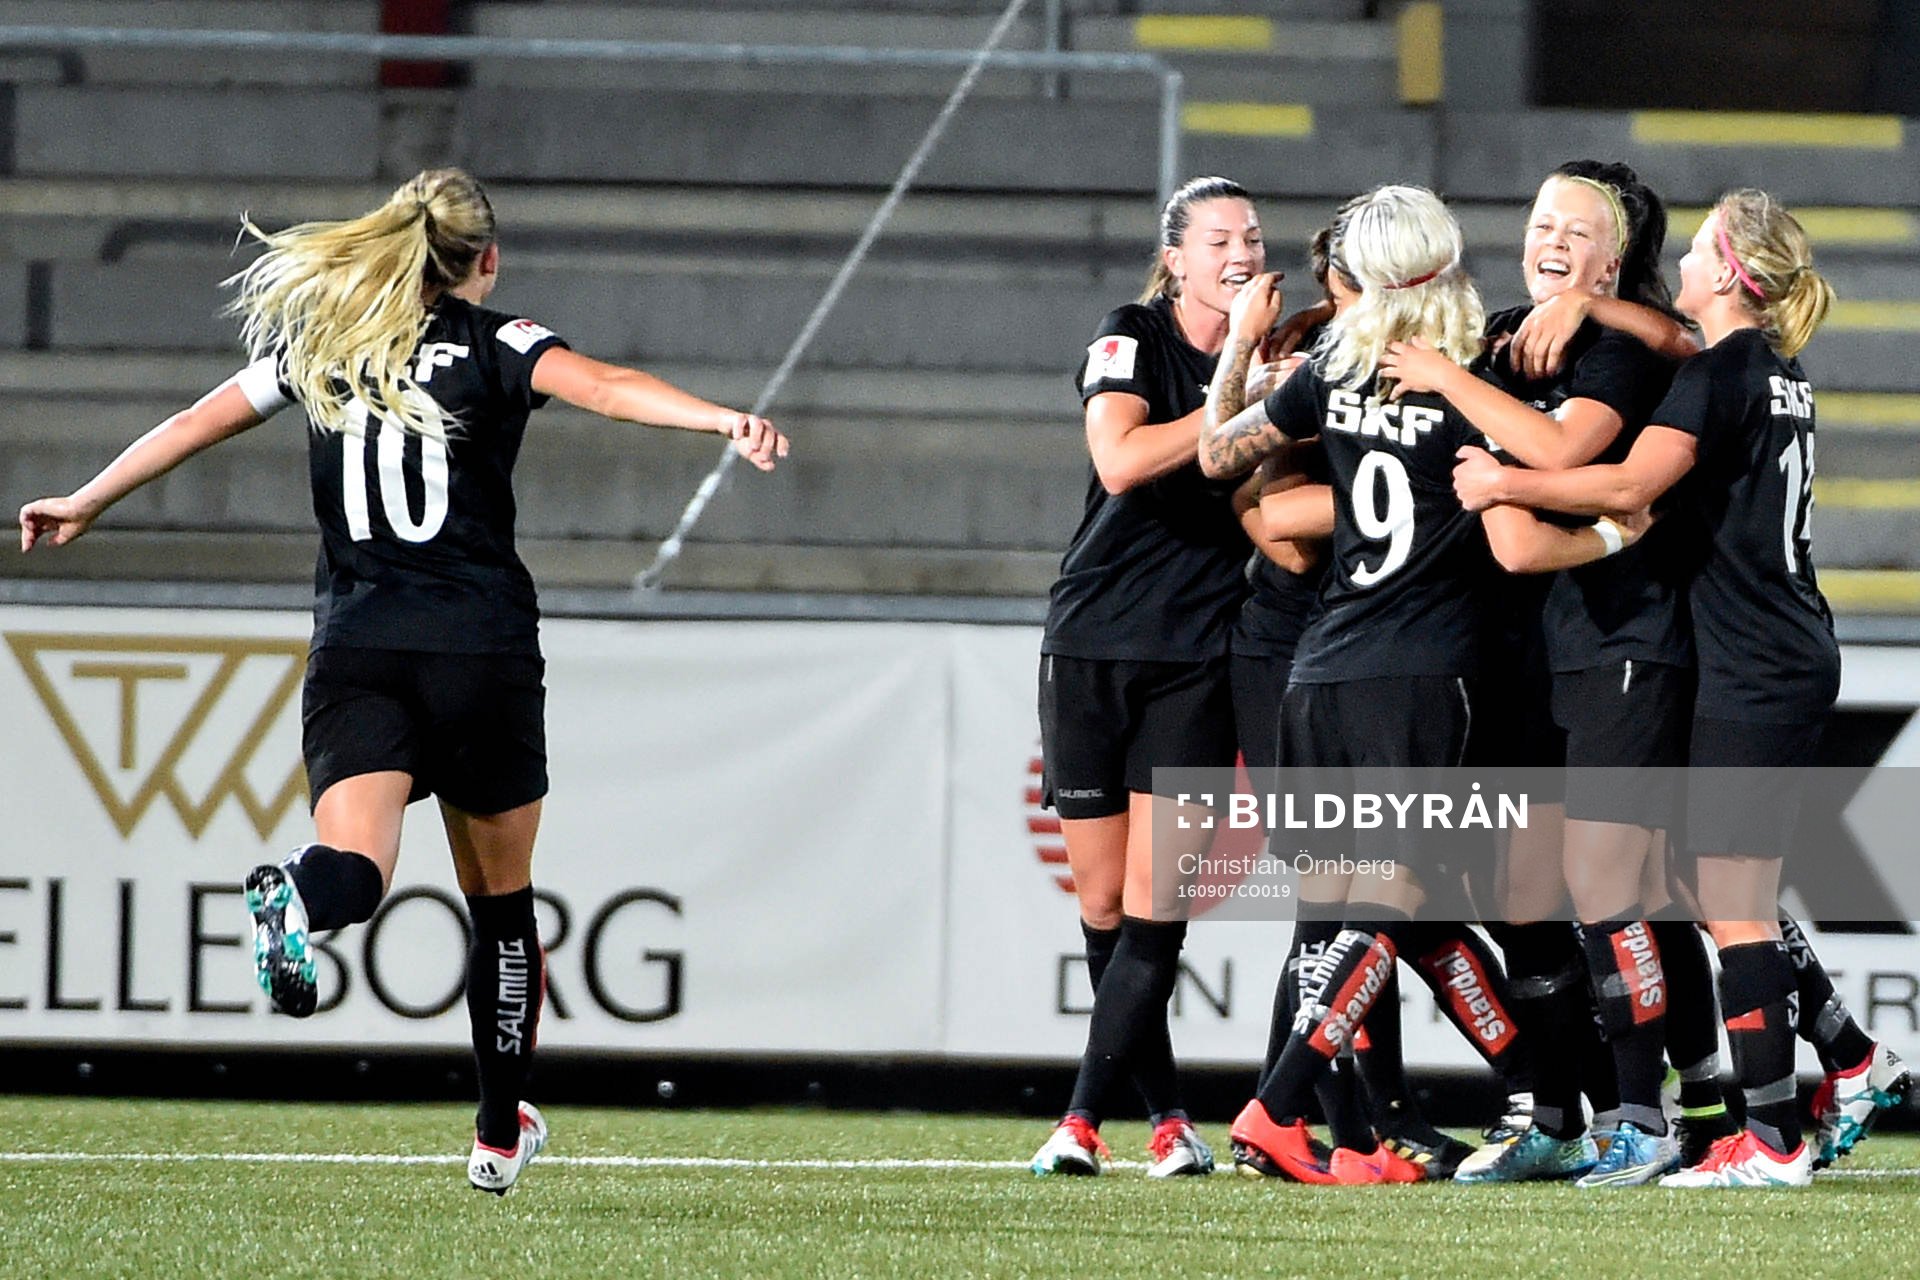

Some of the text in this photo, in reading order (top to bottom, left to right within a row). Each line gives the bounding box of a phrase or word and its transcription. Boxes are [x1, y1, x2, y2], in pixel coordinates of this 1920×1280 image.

[1326, 388, 1443, 446] SKF
[1769, 375, 1813, 418] SKF
[342, 386, 449, 543] 10
[1350, 449, 1415, 586] 9
[496, 938, 528, 1055] SALMING
[1433, 950, 1505, 1041] Stavdal
[1621, 921, 1663, 1007] Stavda
